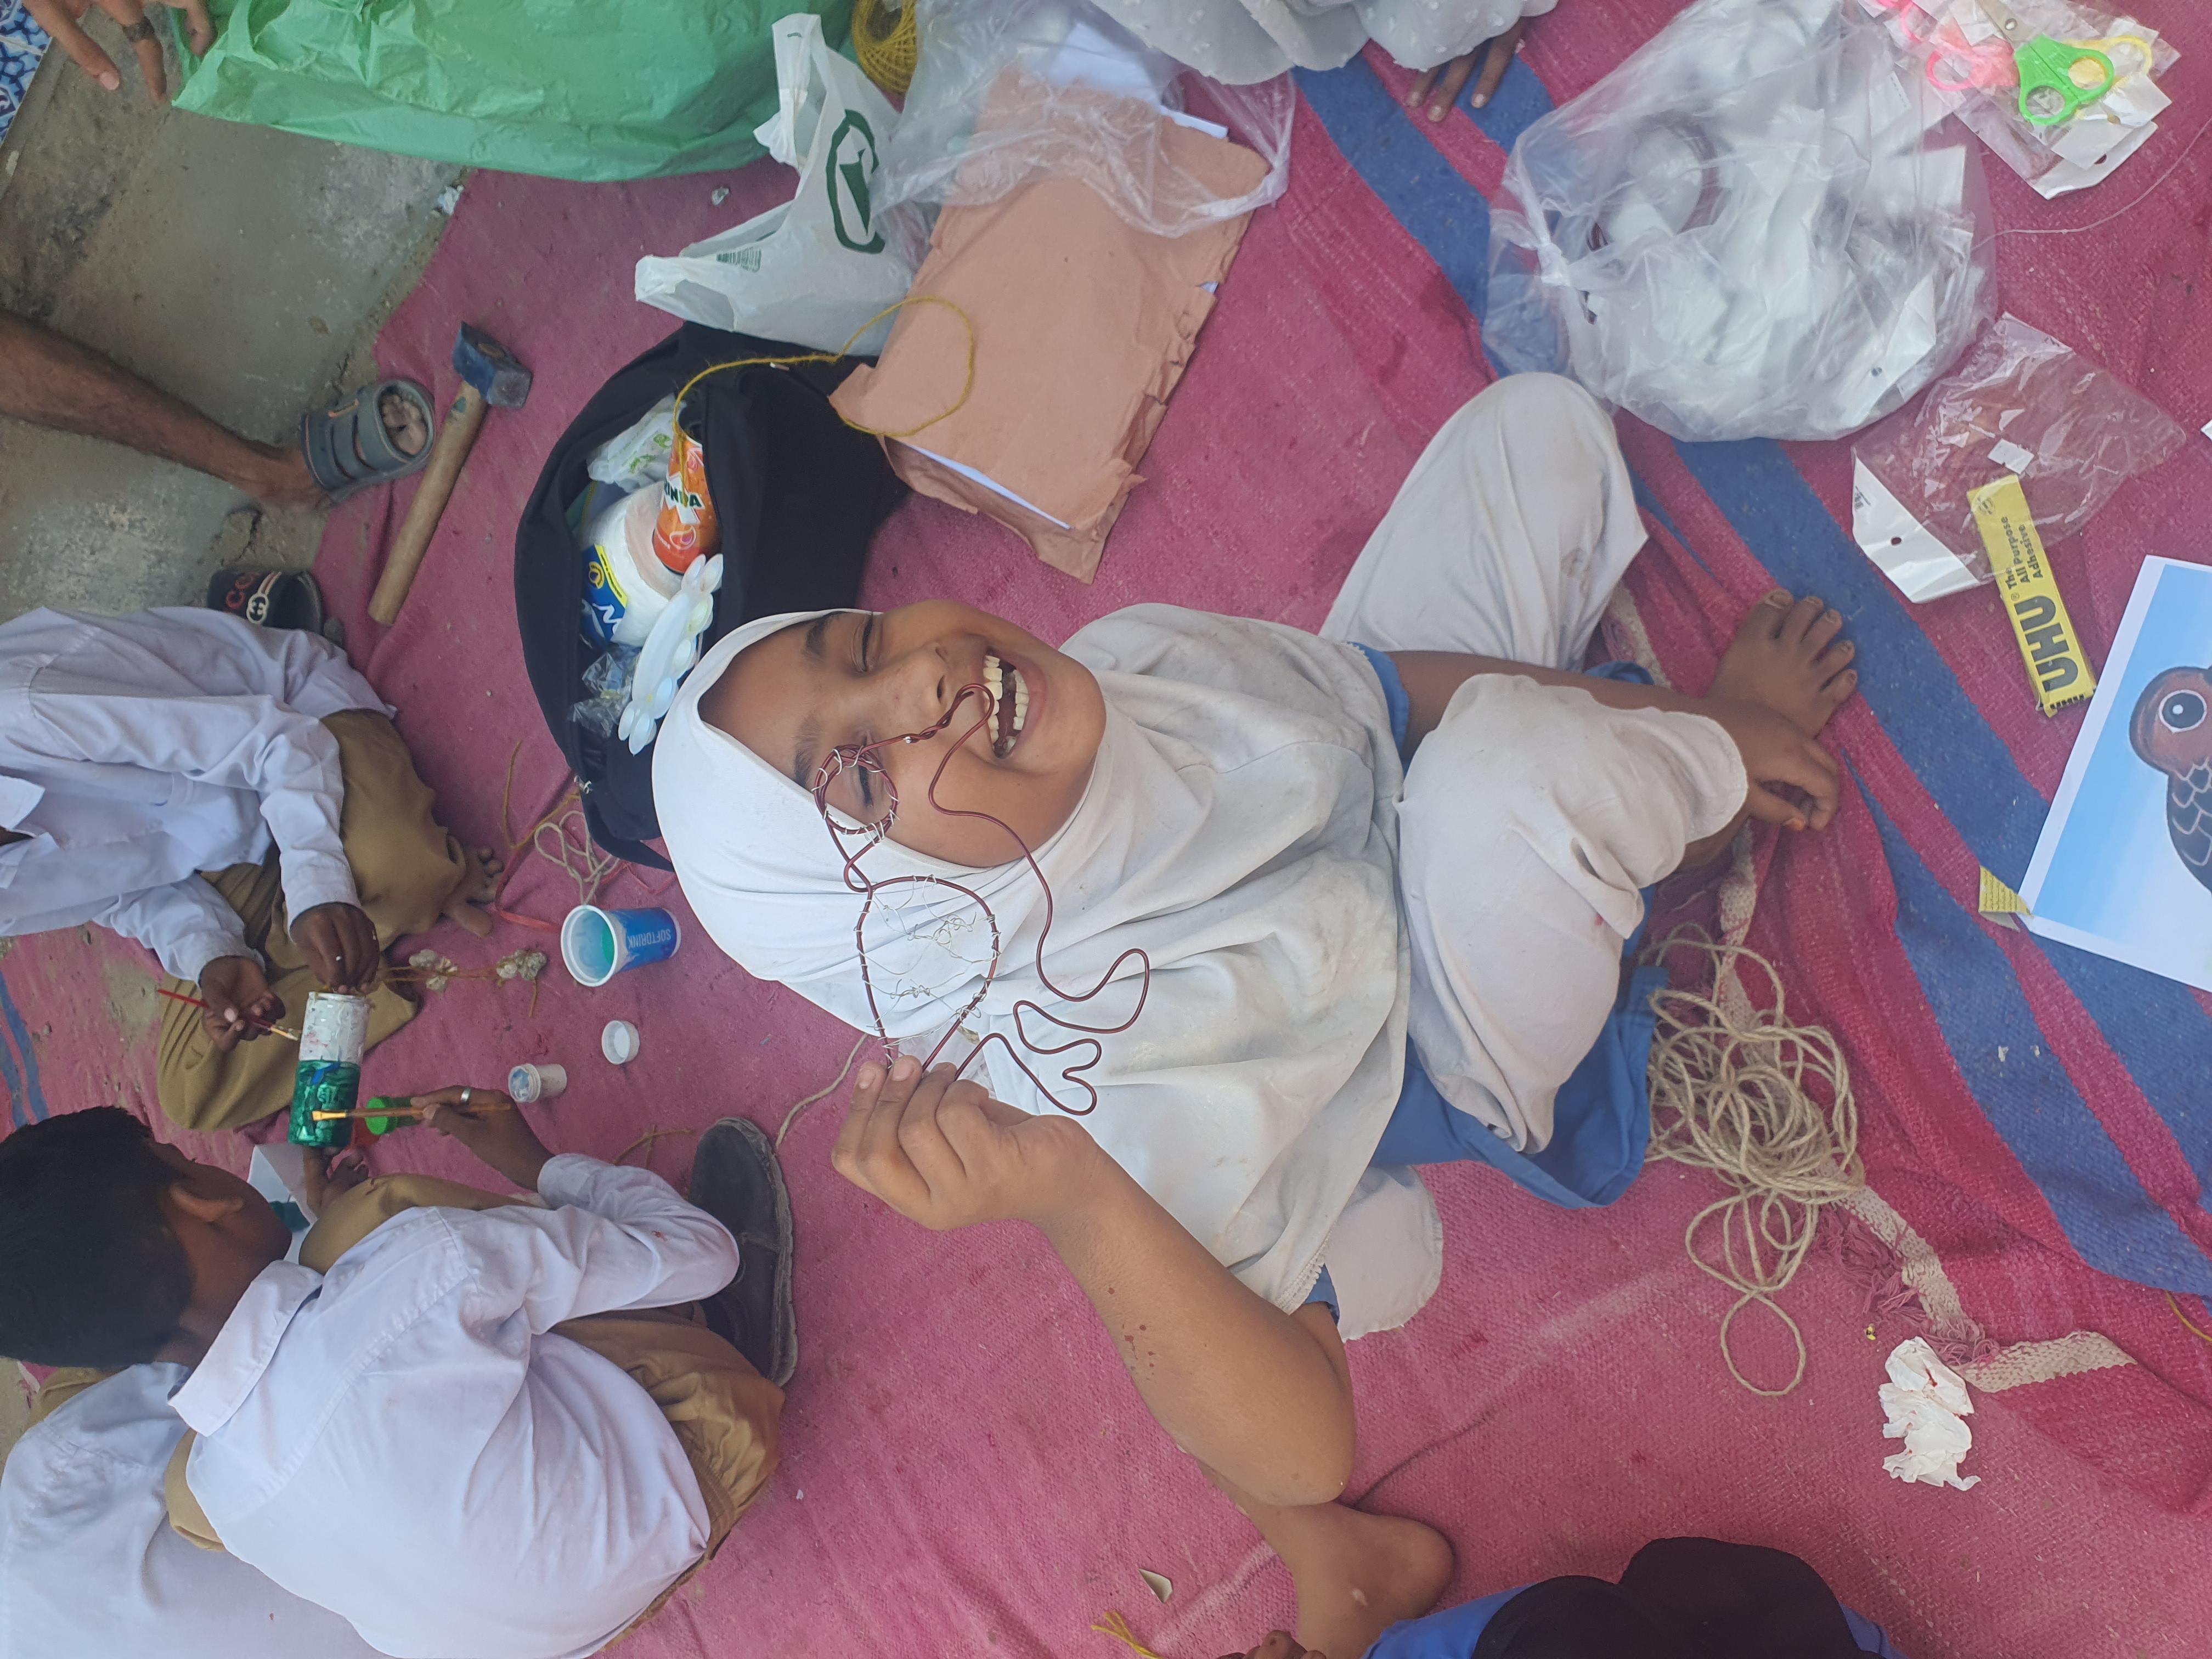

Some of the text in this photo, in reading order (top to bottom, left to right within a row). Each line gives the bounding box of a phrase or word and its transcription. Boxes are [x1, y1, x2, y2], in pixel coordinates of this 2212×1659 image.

[2001, 516, 2030, 583] All Purpose
[2018, 524, 2044, 578] Adhesive
[2005, 567, 2017, 590] The
[2013, 595, 2079, 693] UHU
[627, 928, 672, 949] SOFTDRINK
